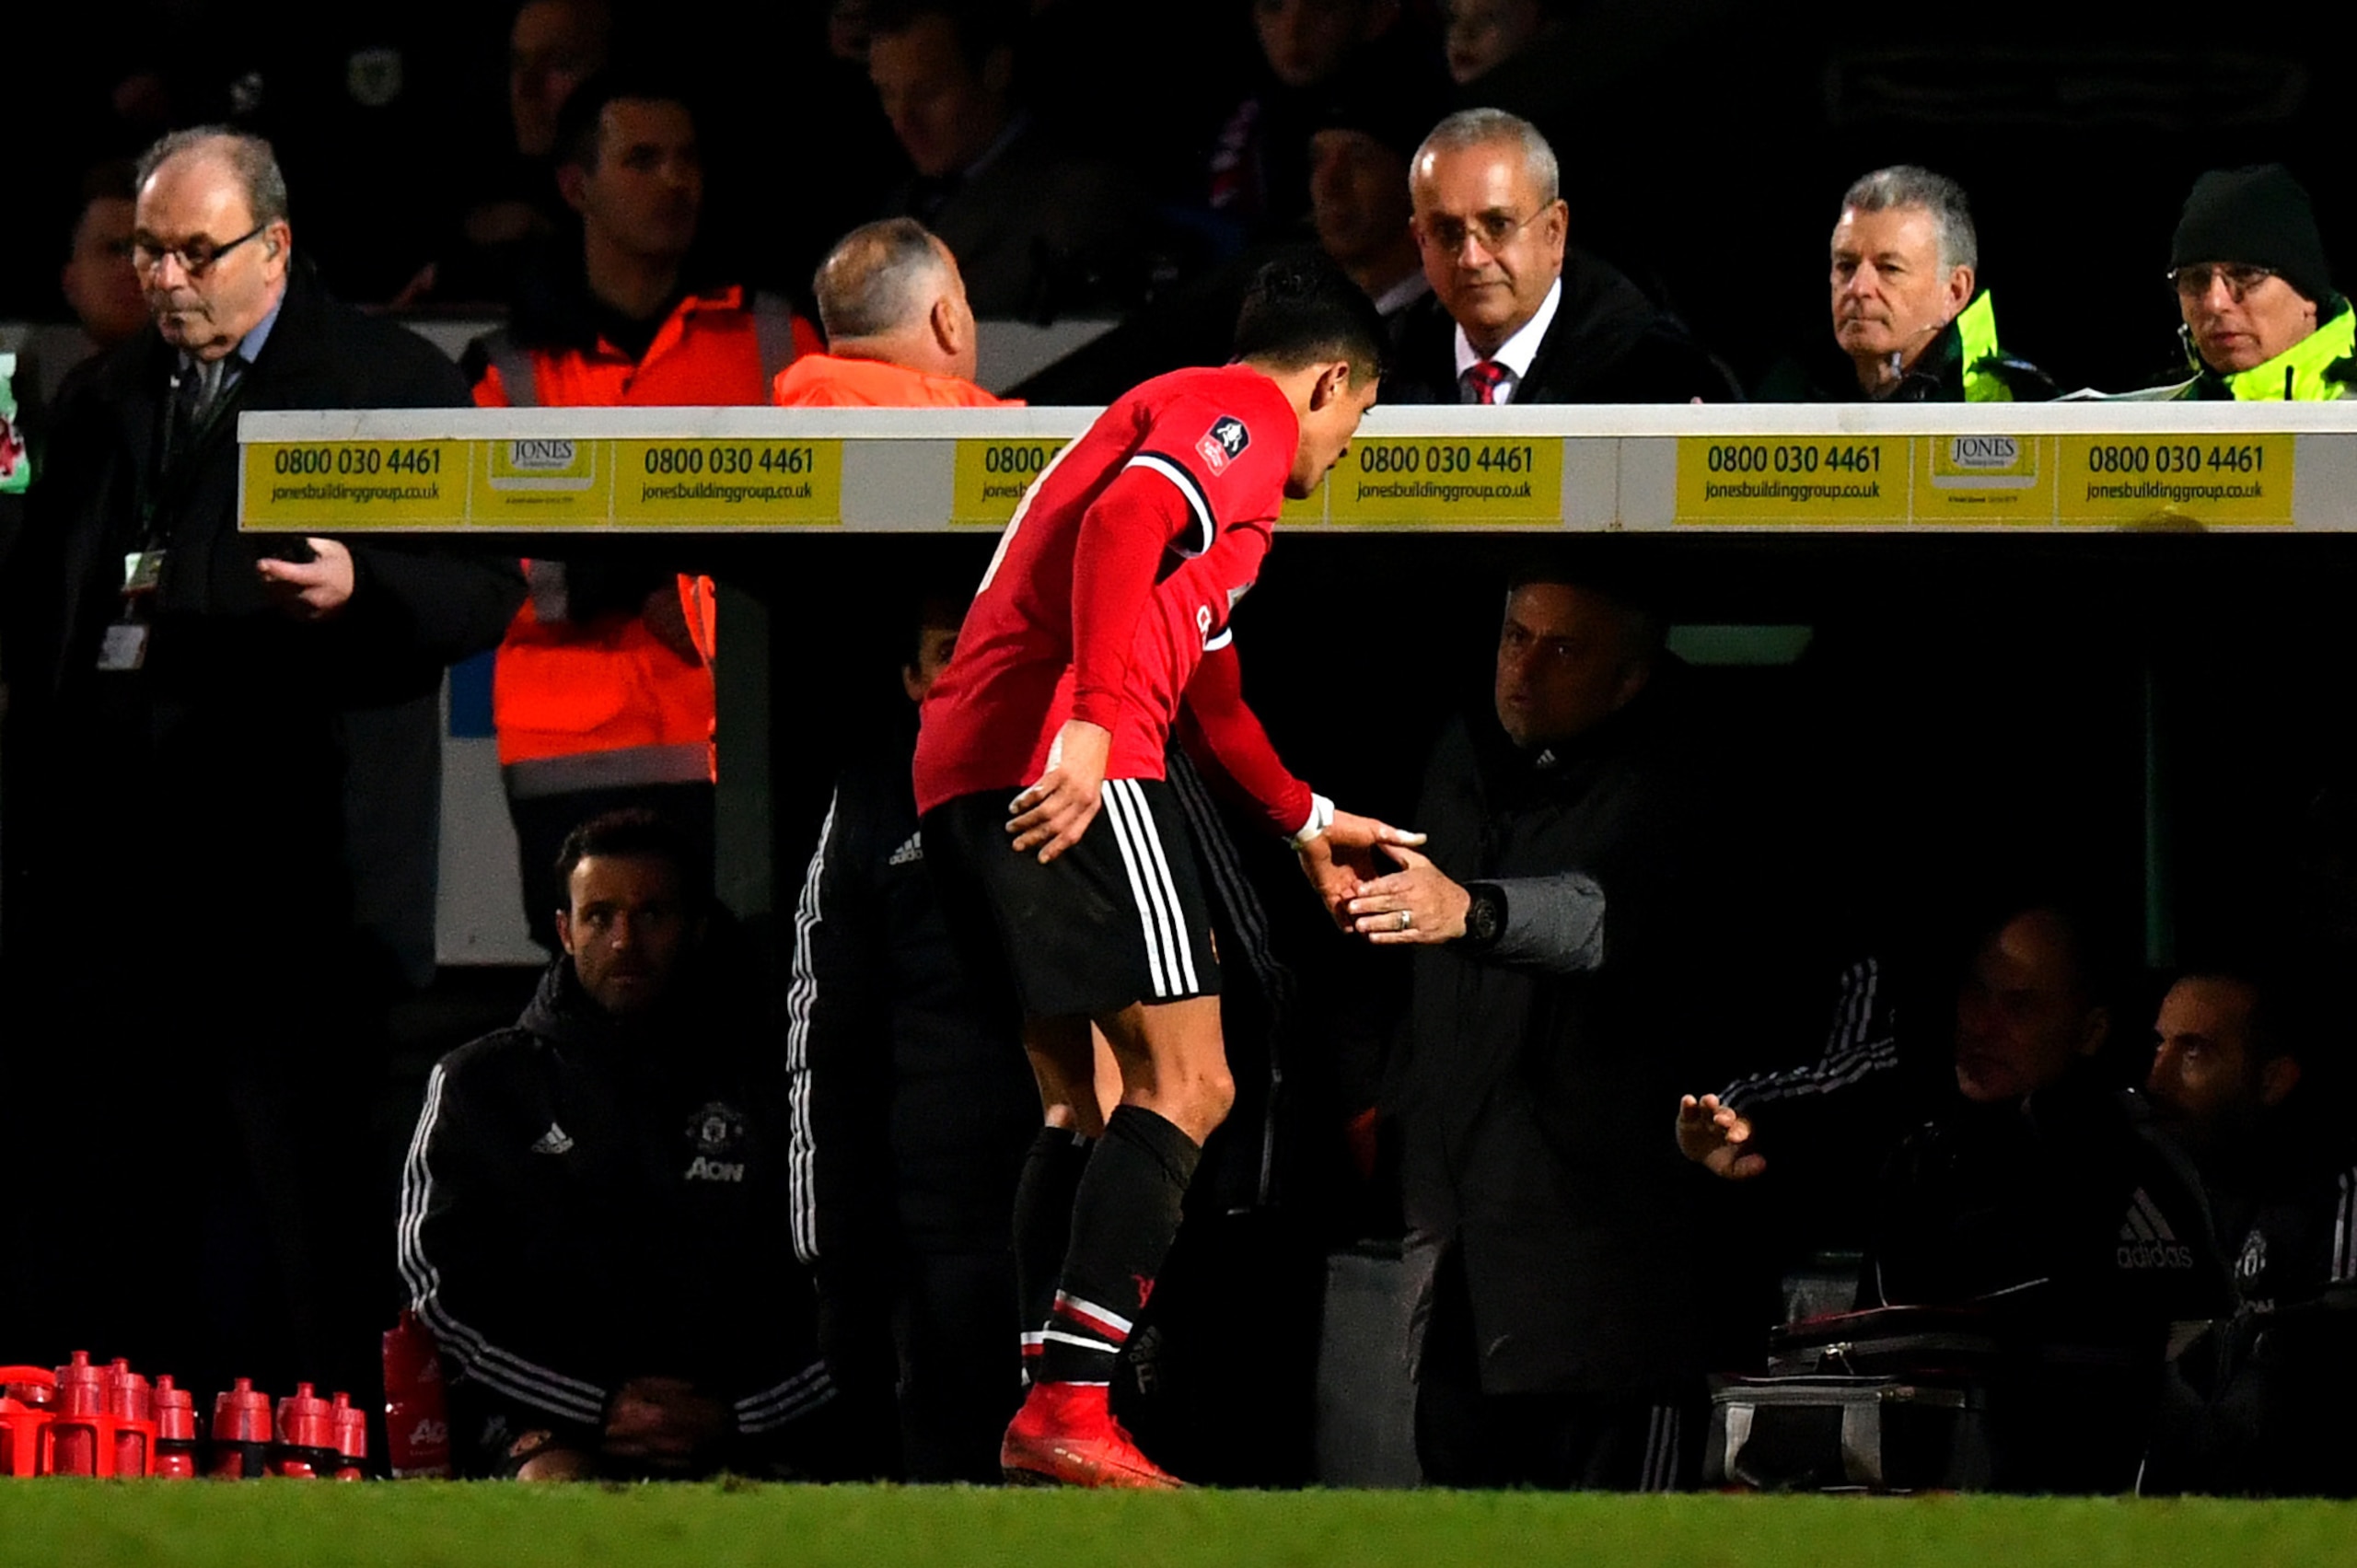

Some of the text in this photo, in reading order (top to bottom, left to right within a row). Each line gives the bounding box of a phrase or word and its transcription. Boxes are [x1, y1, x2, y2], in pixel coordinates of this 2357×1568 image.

[274, 447, 441, 475] 0800 030 4461
[509, 440, 573, 465] JONES
[644, 447, 813, 474] 0800 030 4461
[985, 447, 1044, 473] 0800
[1360, 446, 1532, 473] 0800 030 4461
[1708, 446, 1880, 472] 0800 030 4461
[1953, 438, 2015, 463] JONES
[2089, 446, 2263, 473] 0800 030 4461
[271, 482, 439, 504] jonesbuildinggroup.co.uk
[641, 482, 812, 503] jonesbuildinggroup.co.uk
[1355, 481, 1532, 503] jonesbuildinggroup.co.uk
[1704, 480, 1880, 502] jonesbuildinggroup.co.uk
[2085, 480, 2263, 503] jonesbuildinggroup.co.uk
[2116, 1237, 2194, 1270] adidas
